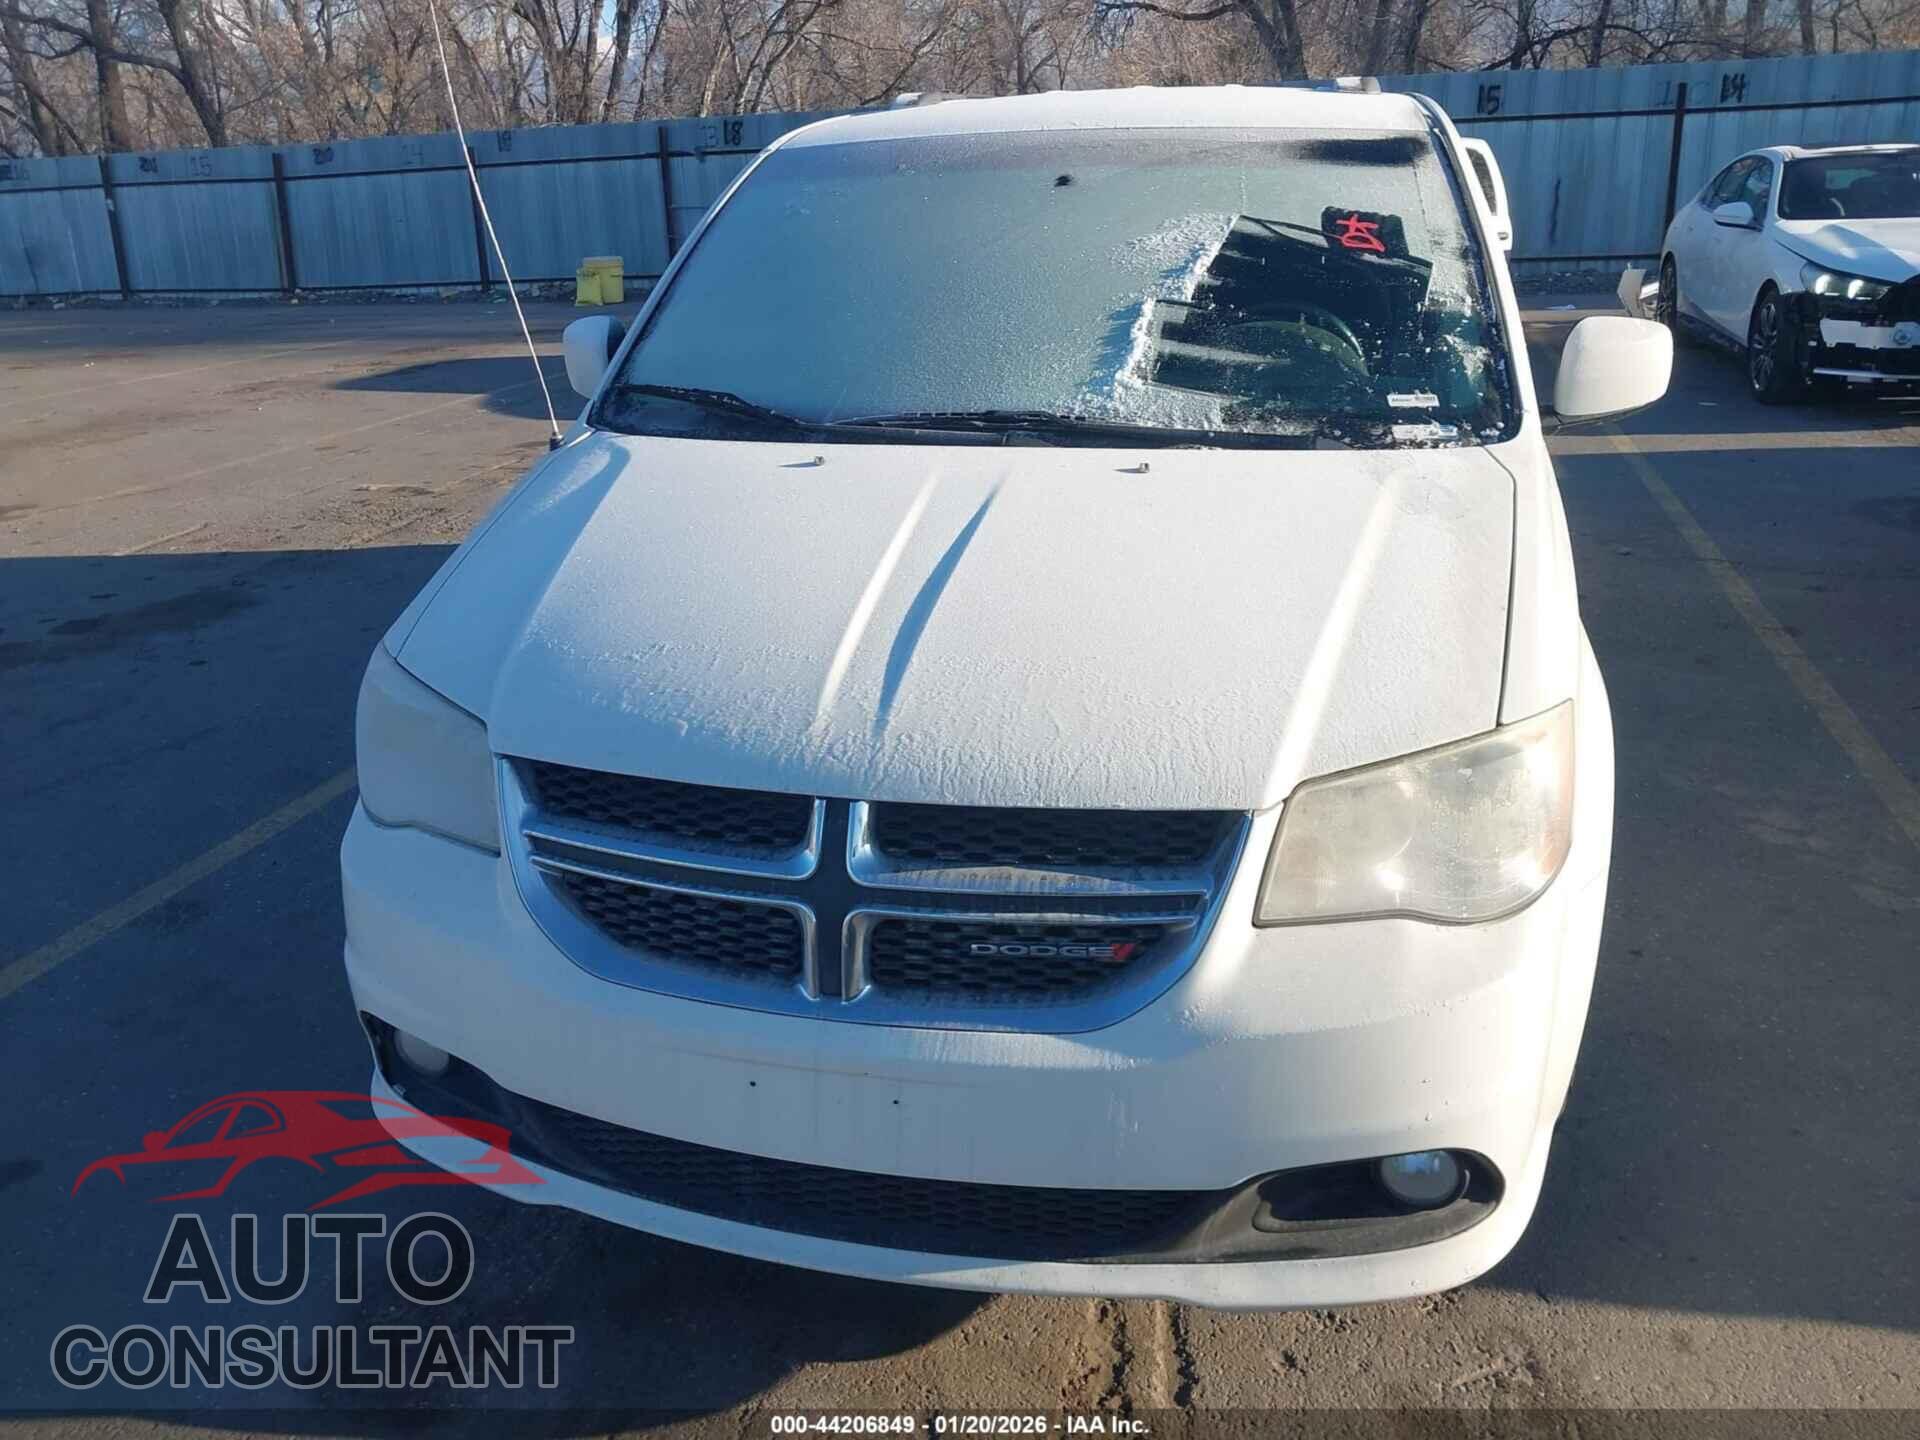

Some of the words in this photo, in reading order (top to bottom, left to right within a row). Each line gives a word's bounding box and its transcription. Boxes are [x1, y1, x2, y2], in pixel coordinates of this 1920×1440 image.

[1477, 84, 1502, 115] 15
[723, 119, 744, 146] 18
[970, 943, 1115, 957] DODGE
